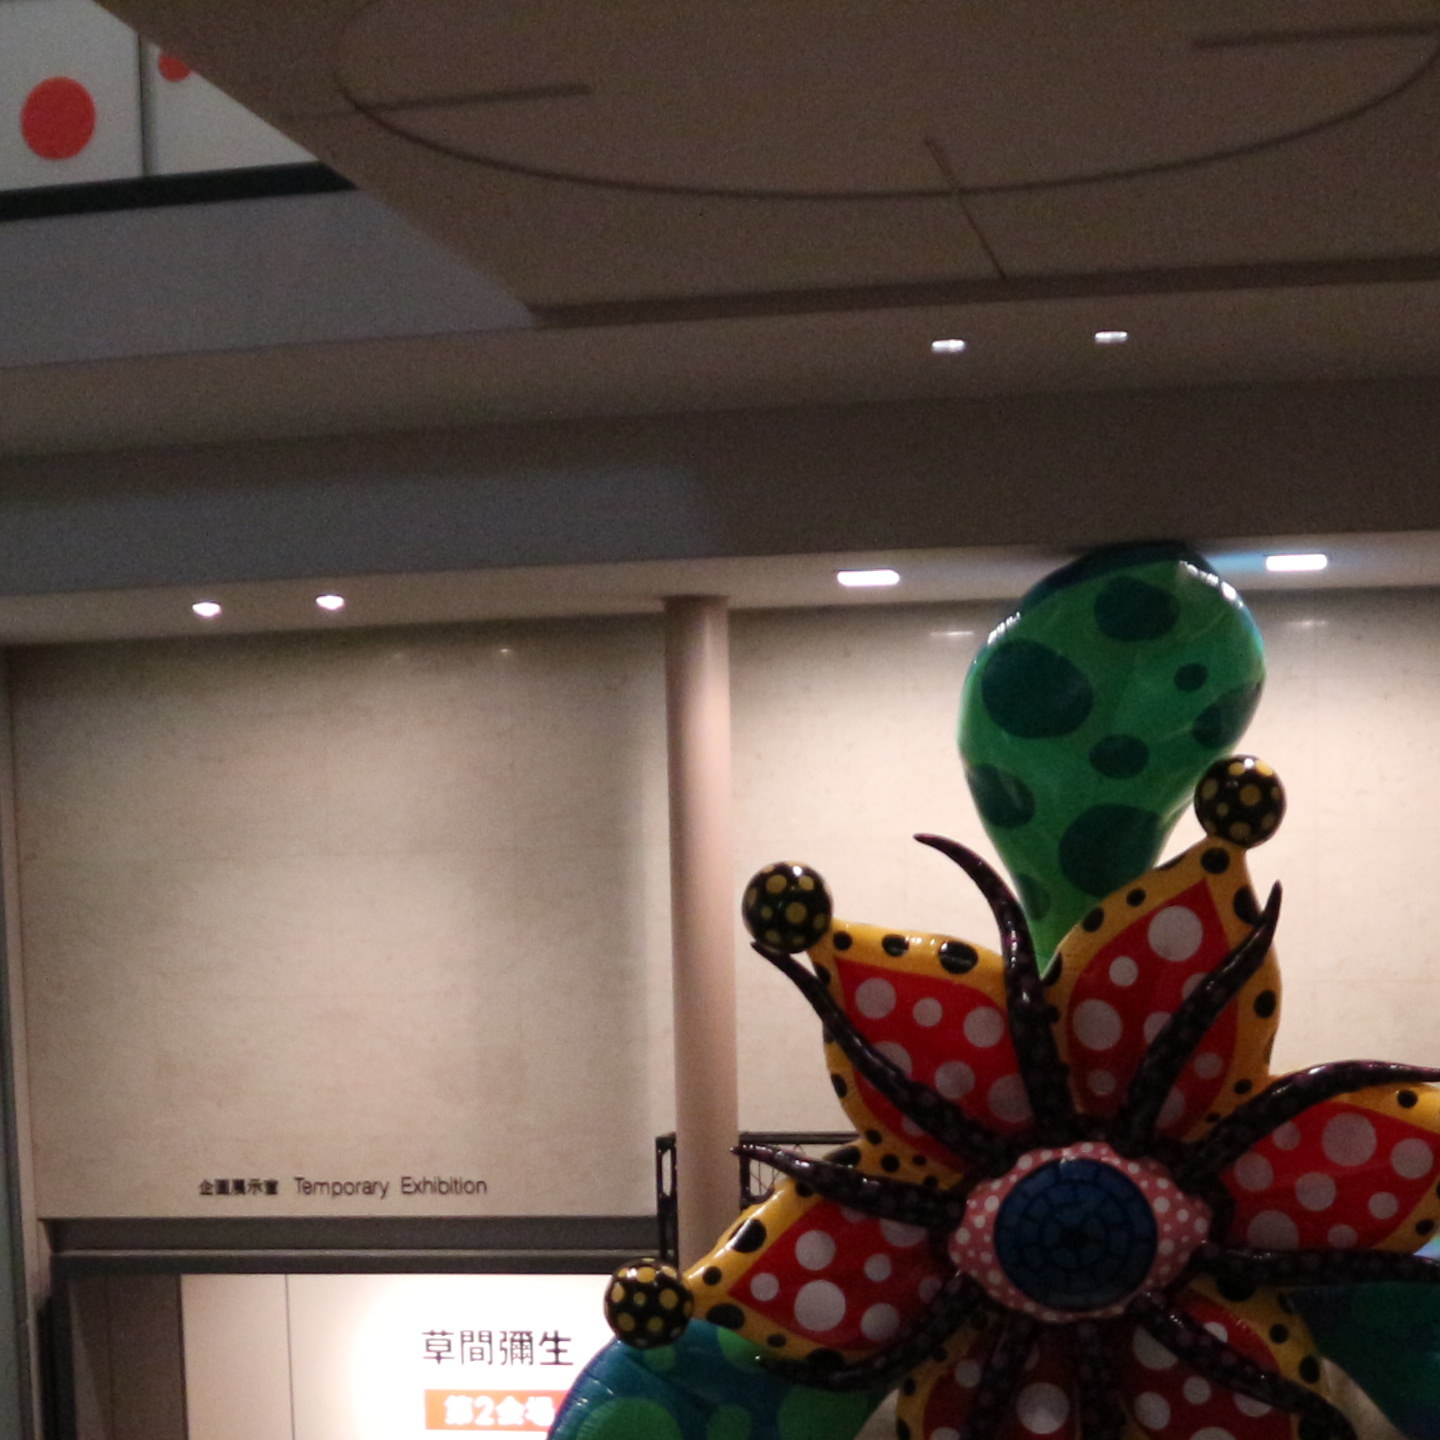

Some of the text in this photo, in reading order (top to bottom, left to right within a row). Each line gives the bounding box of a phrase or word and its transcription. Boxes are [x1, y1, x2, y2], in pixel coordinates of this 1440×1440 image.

[294, 1175, 390, 1200] Temporary
[400, 1175, 488, 1197] Exhibition
[421, 1328, 574, 1366] 草間彌生
